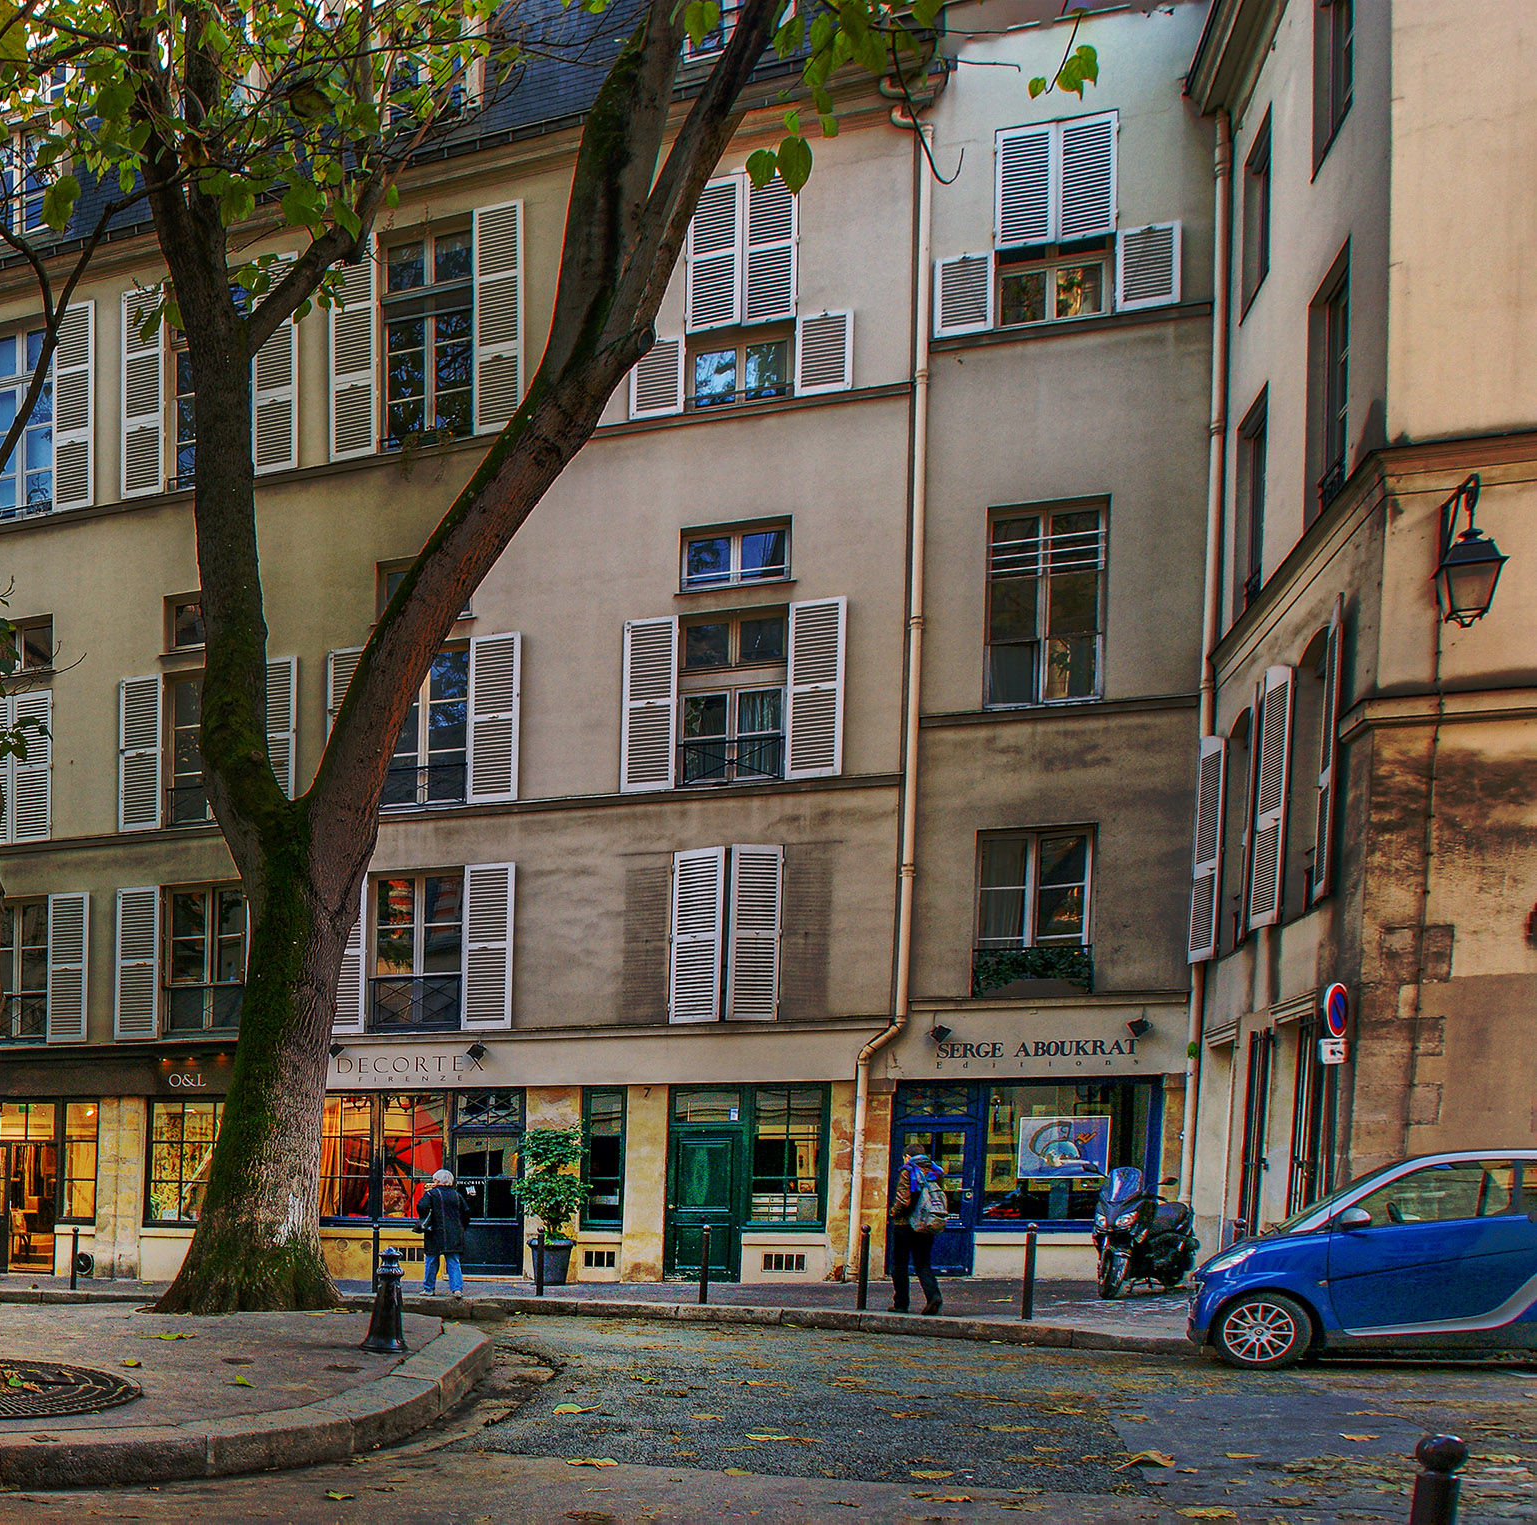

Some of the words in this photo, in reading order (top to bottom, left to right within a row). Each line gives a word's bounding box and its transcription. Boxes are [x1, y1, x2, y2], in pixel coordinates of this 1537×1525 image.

[936, 1042, 1003, 1059] SERGE
[1013, 1038, 1140, 1058] ABOUKRAT
[336, 1055, 484, 1074] DECORTEX
[168, 1073, 207, 1088] O&L
[359, 1075, 463, 1083] FIRENZE
[643, 1087, 652, 1098] 7
